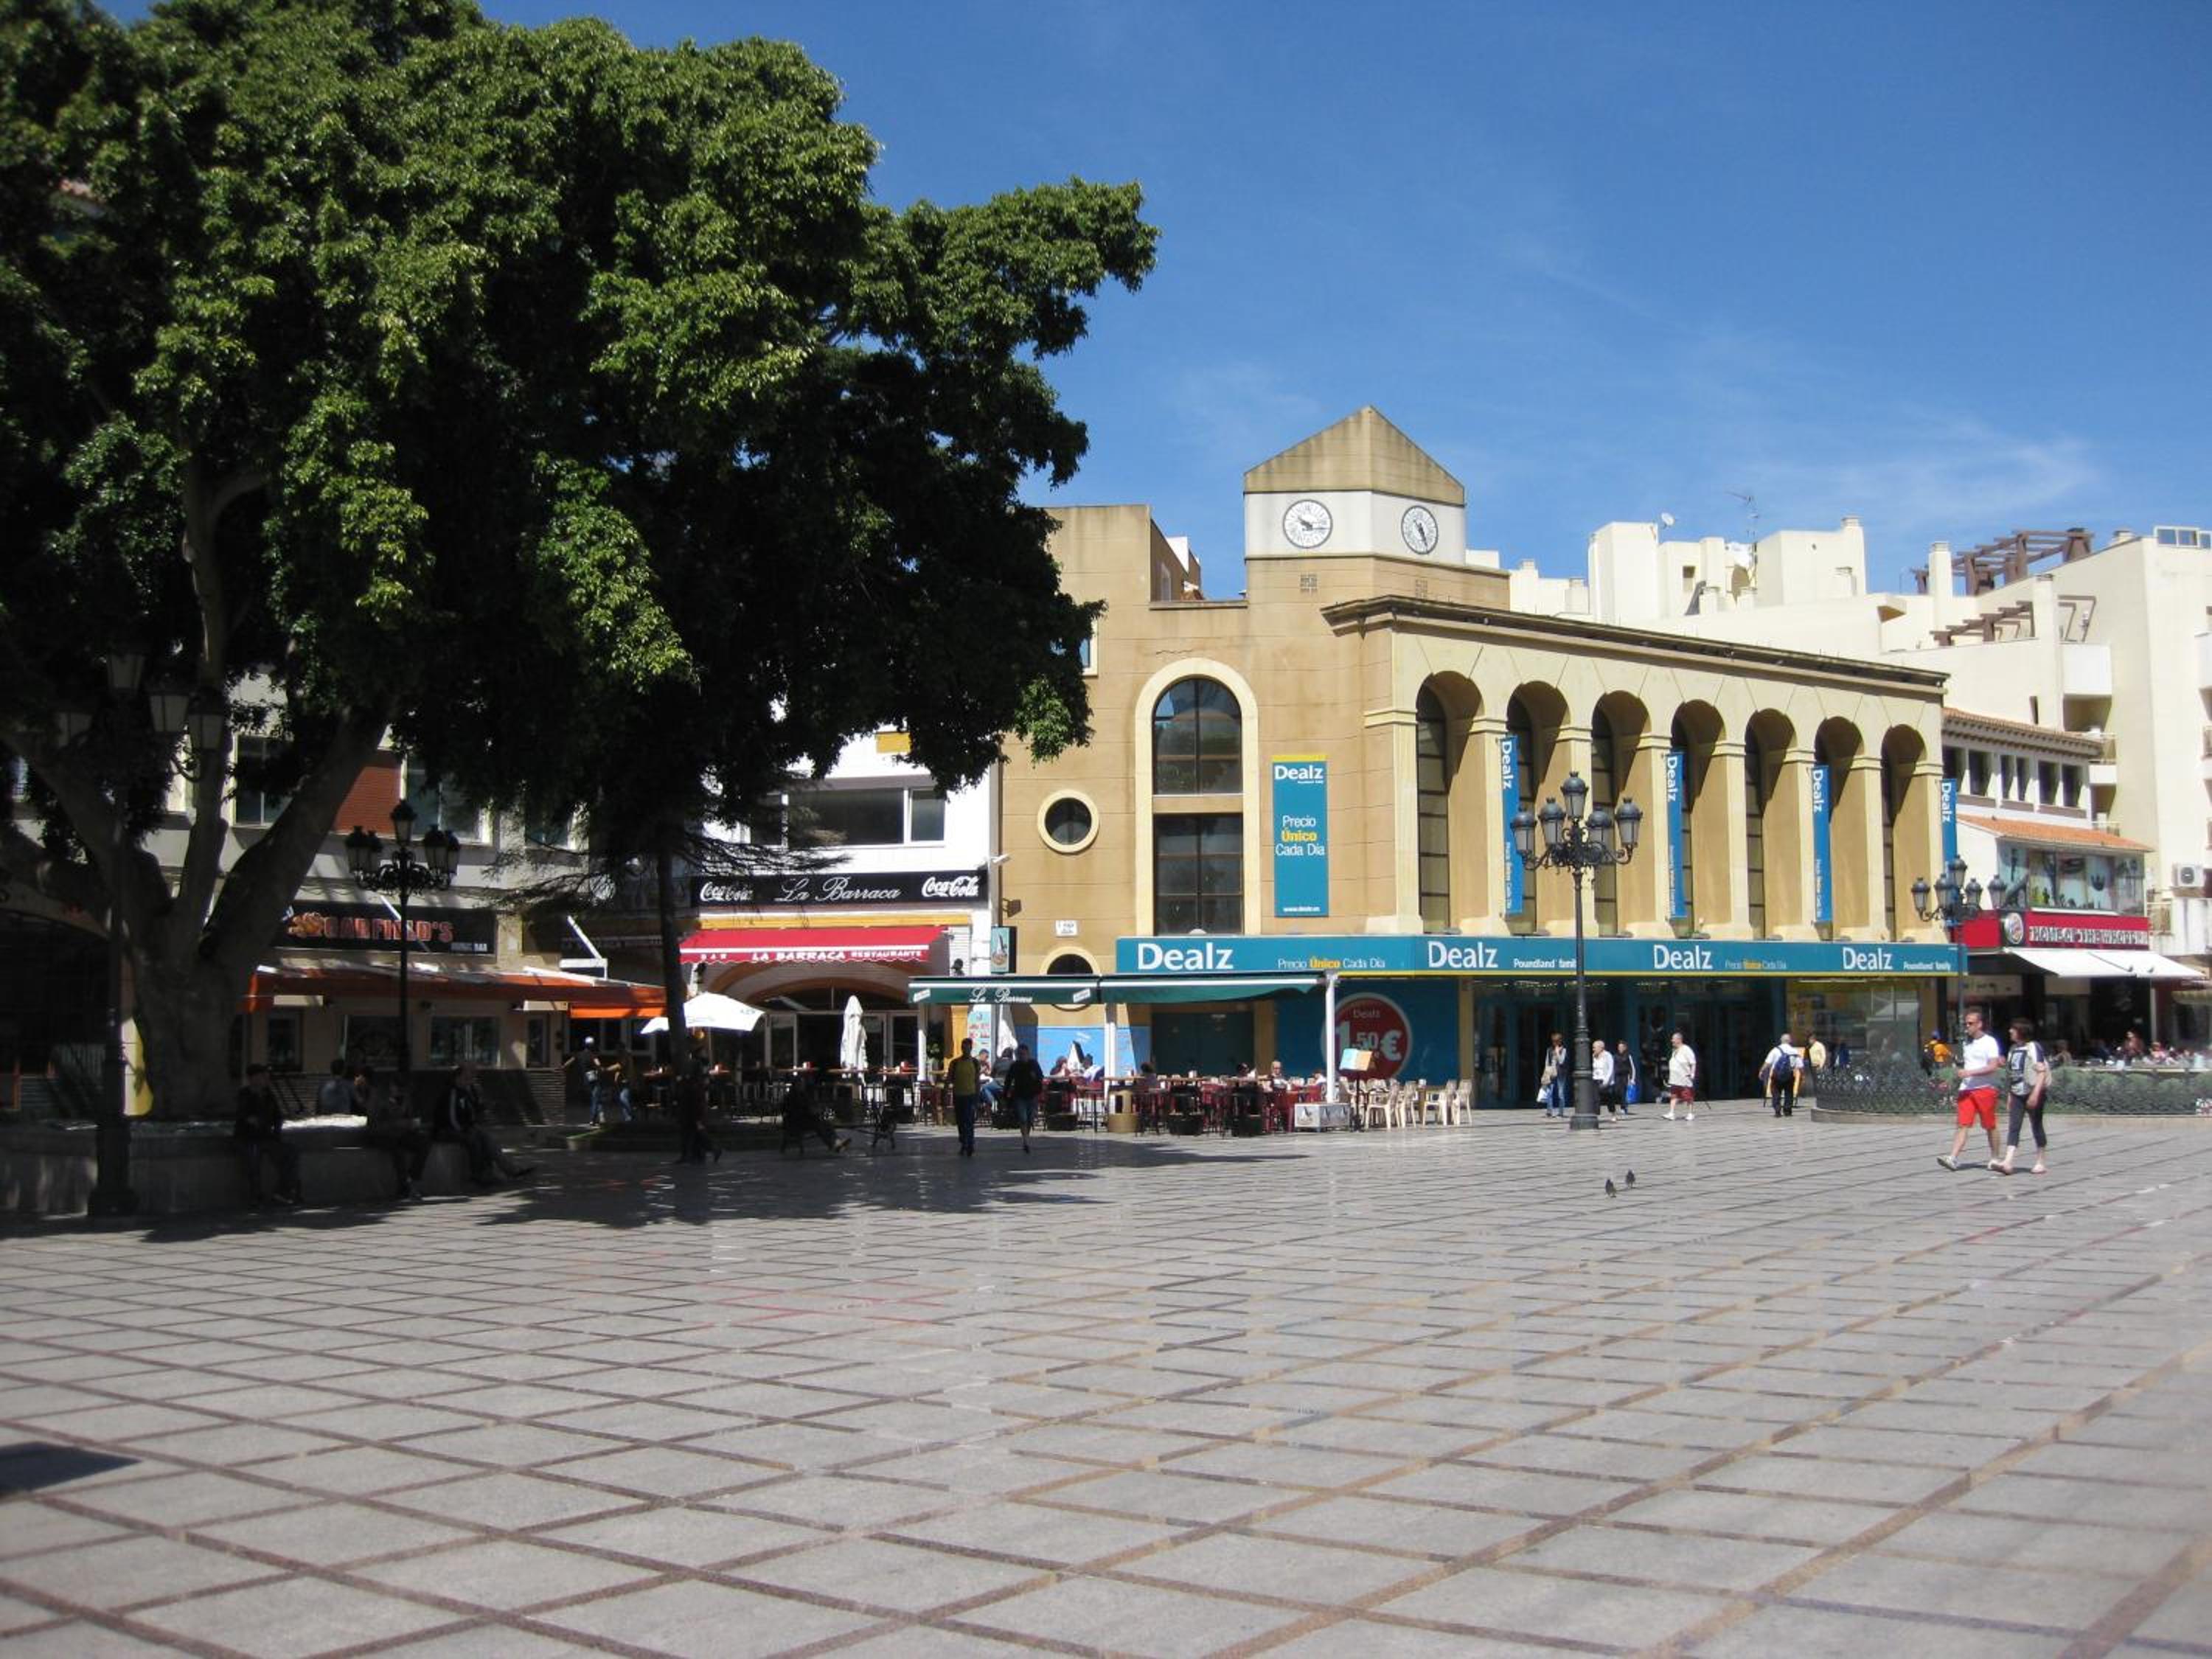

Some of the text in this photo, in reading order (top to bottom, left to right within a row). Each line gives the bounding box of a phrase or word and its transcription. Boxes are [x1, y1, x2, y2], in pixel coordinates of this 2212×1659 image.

[1275, 765, 1324, 779] Dealz
[1502, 740, 1514, 789] Dealz
[1666, 757, 1678, 802] Dealz
[1812, 769, 1824, 813] Dealz
[1941, 782, 1952, 823] Dealz
[1282, 815, 1316, 828] Precio
[1281, 827, 1317, 842] Único
[1276, 844, 1304, 856] Cada
[774, 875, 903, 902] La Barraca
[752, 952, 770, 961] LA
[776, 951, 846, 960] BARRACA
[1138, 942, 1234, 971] Dealz
[1278, 959, 1307, 969] Precio
[1343, 958, 1366, 969] Cada
[1427, 941, 1499, 968] Dealz
[1654, 945, 1713, 970] Dealz
[1843, 947, 1893, 970] Dealz
